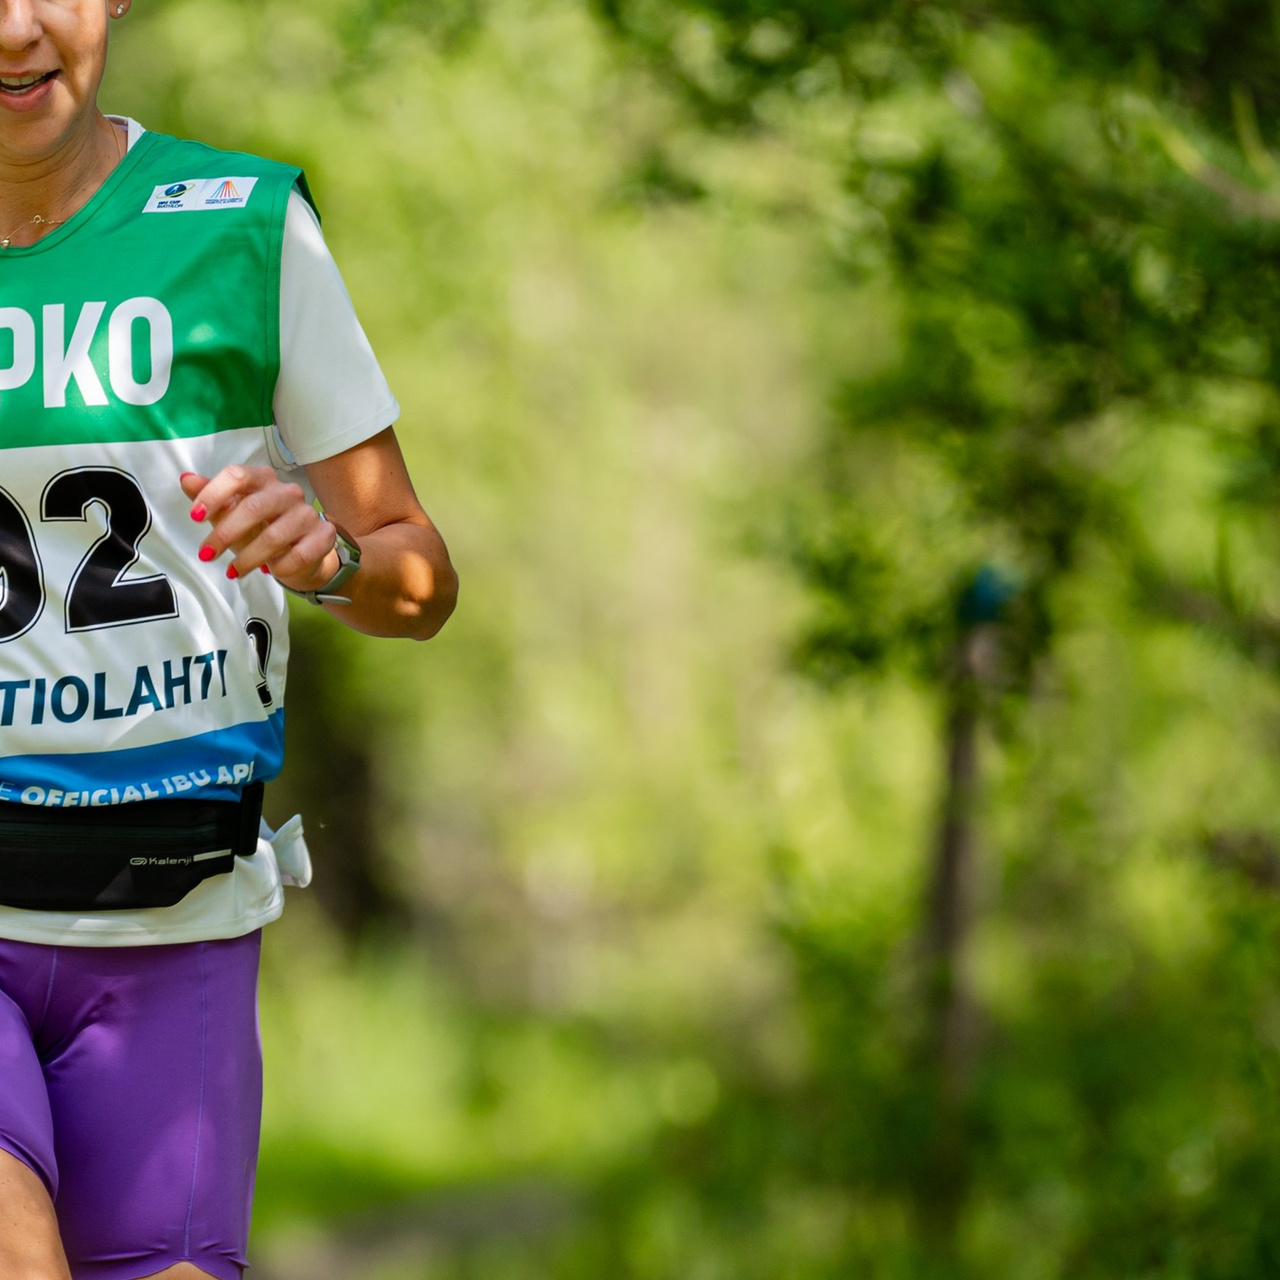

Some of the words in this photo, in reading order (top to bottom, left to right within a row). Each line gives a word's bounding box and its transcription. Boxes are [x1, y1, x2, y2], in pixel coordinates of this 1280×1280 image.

[20, 782, 159, 808] OFFICIAL
[161, 769, 211, 795] IBU
[148, 857, 192, 866] Kalenji
